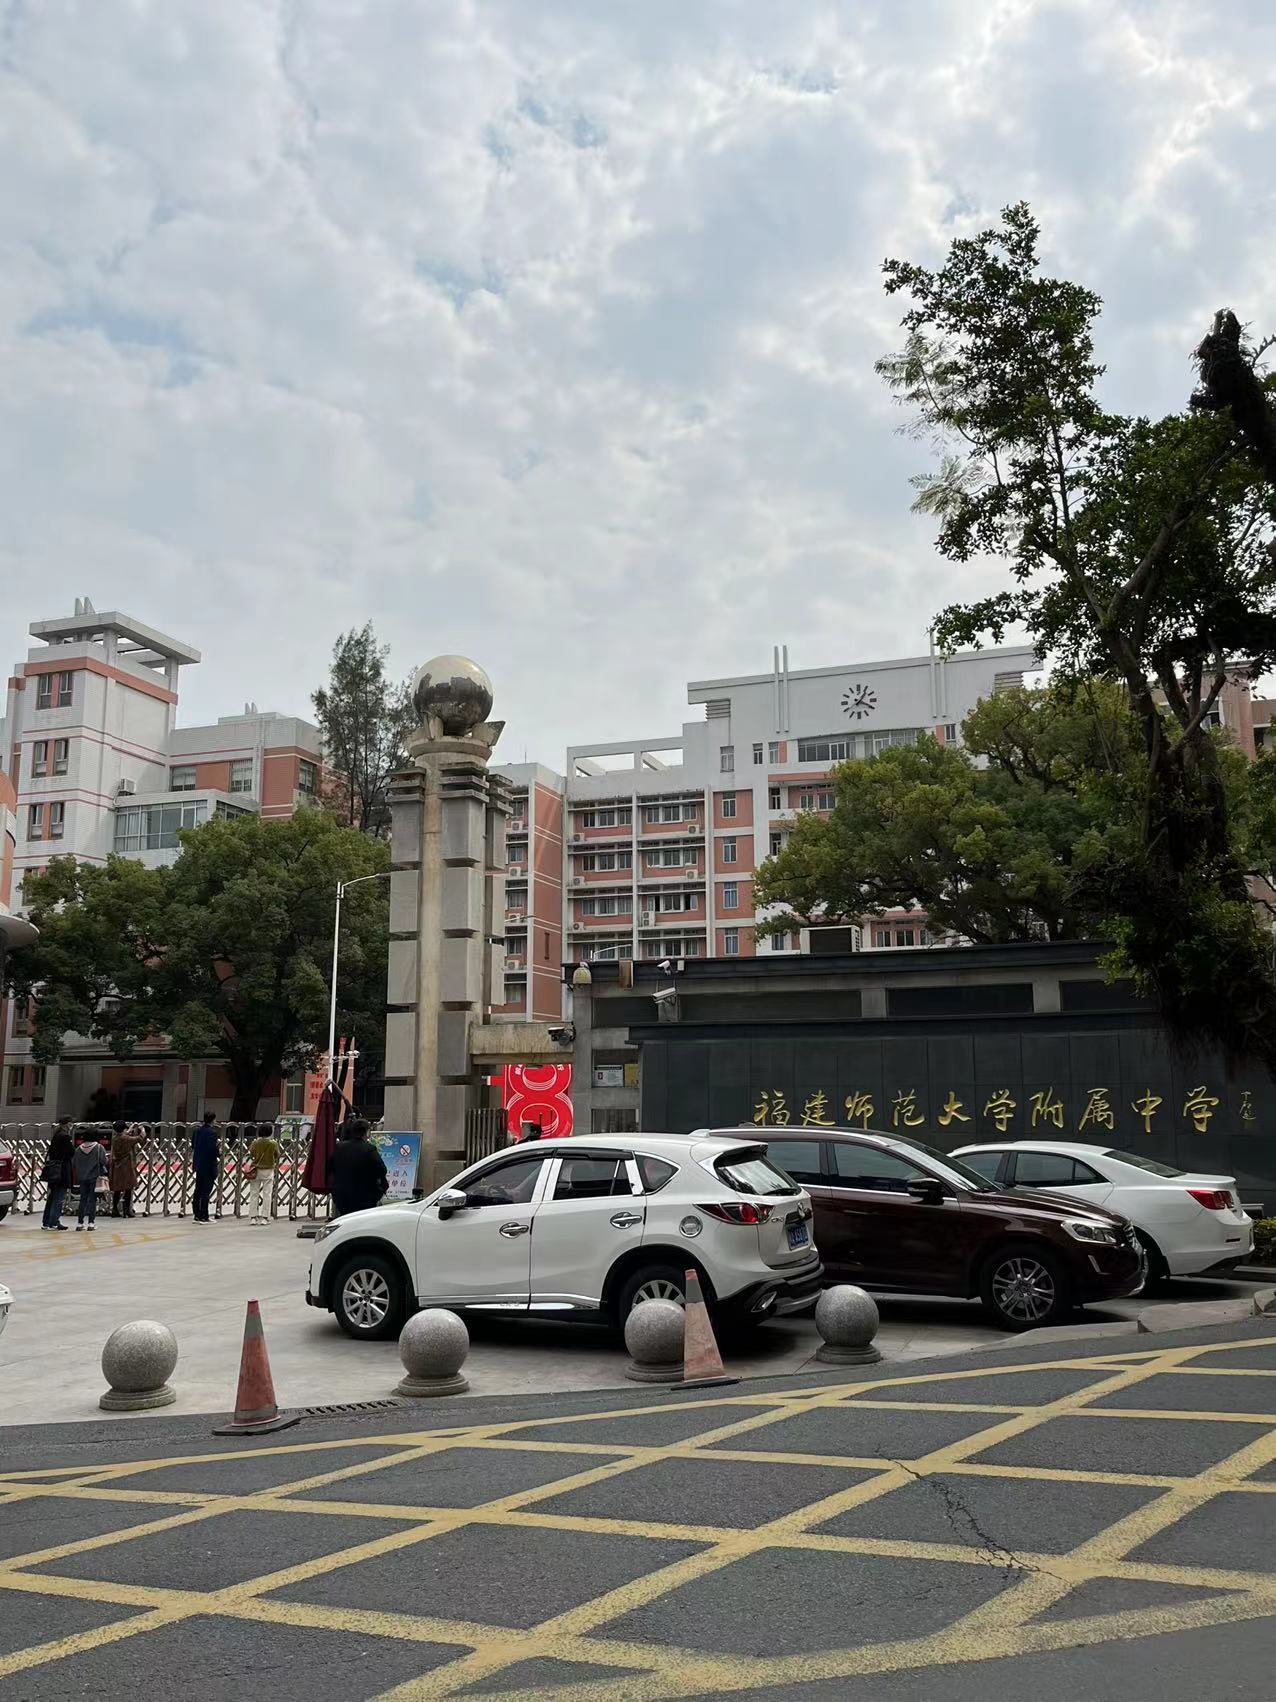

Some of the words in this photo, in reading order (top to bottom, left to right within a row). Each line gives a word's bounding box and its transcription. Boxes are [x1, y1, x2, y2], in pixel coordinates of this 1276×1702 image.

[753, 1085, 1220, 1133] 福建师范大学附属中学
